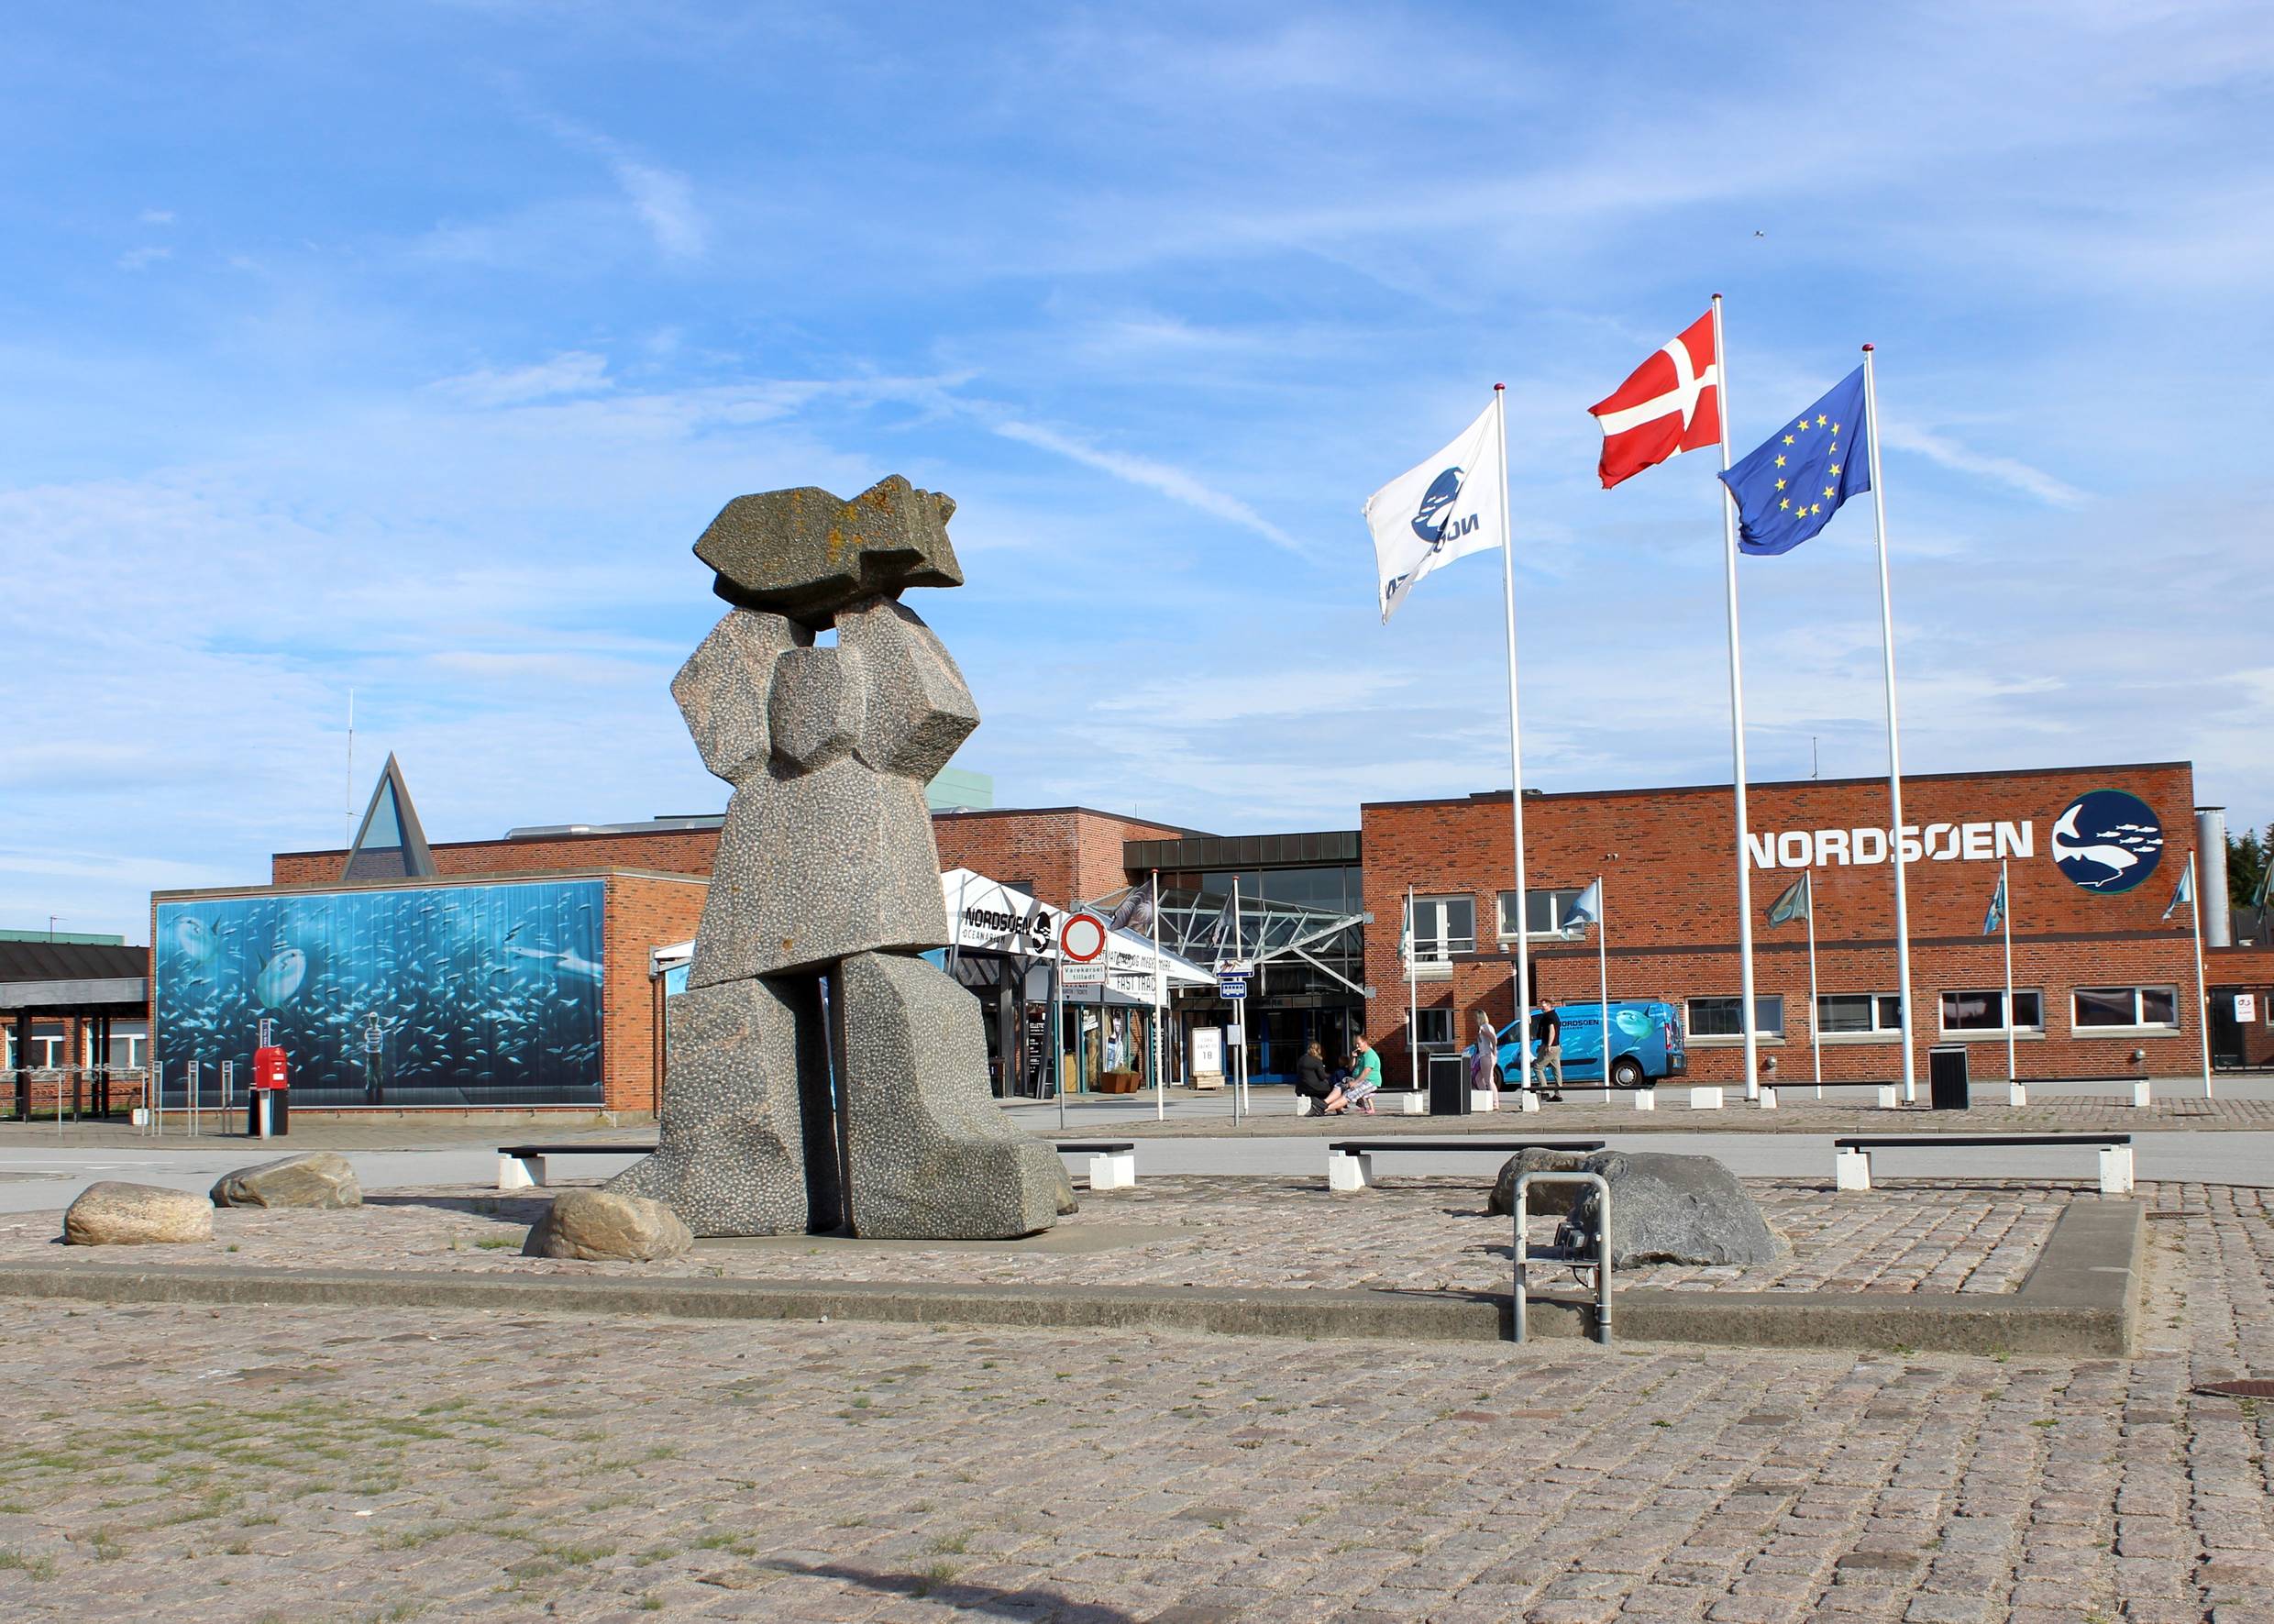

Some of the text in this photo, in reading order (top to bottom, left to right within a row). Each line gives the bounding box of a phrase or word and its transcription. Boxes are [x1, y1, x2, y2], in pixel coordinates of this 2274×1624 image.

[1747, 821, 2034, 869] NORDSØEN
[966, 907, 1032, 935] NORDSØEN
[963, 929, 1006, 944] OCEANARIUM
[1140, 956, 1156, 968] MEGE
[1117, 976, 1156, 991] FAST TRAC
